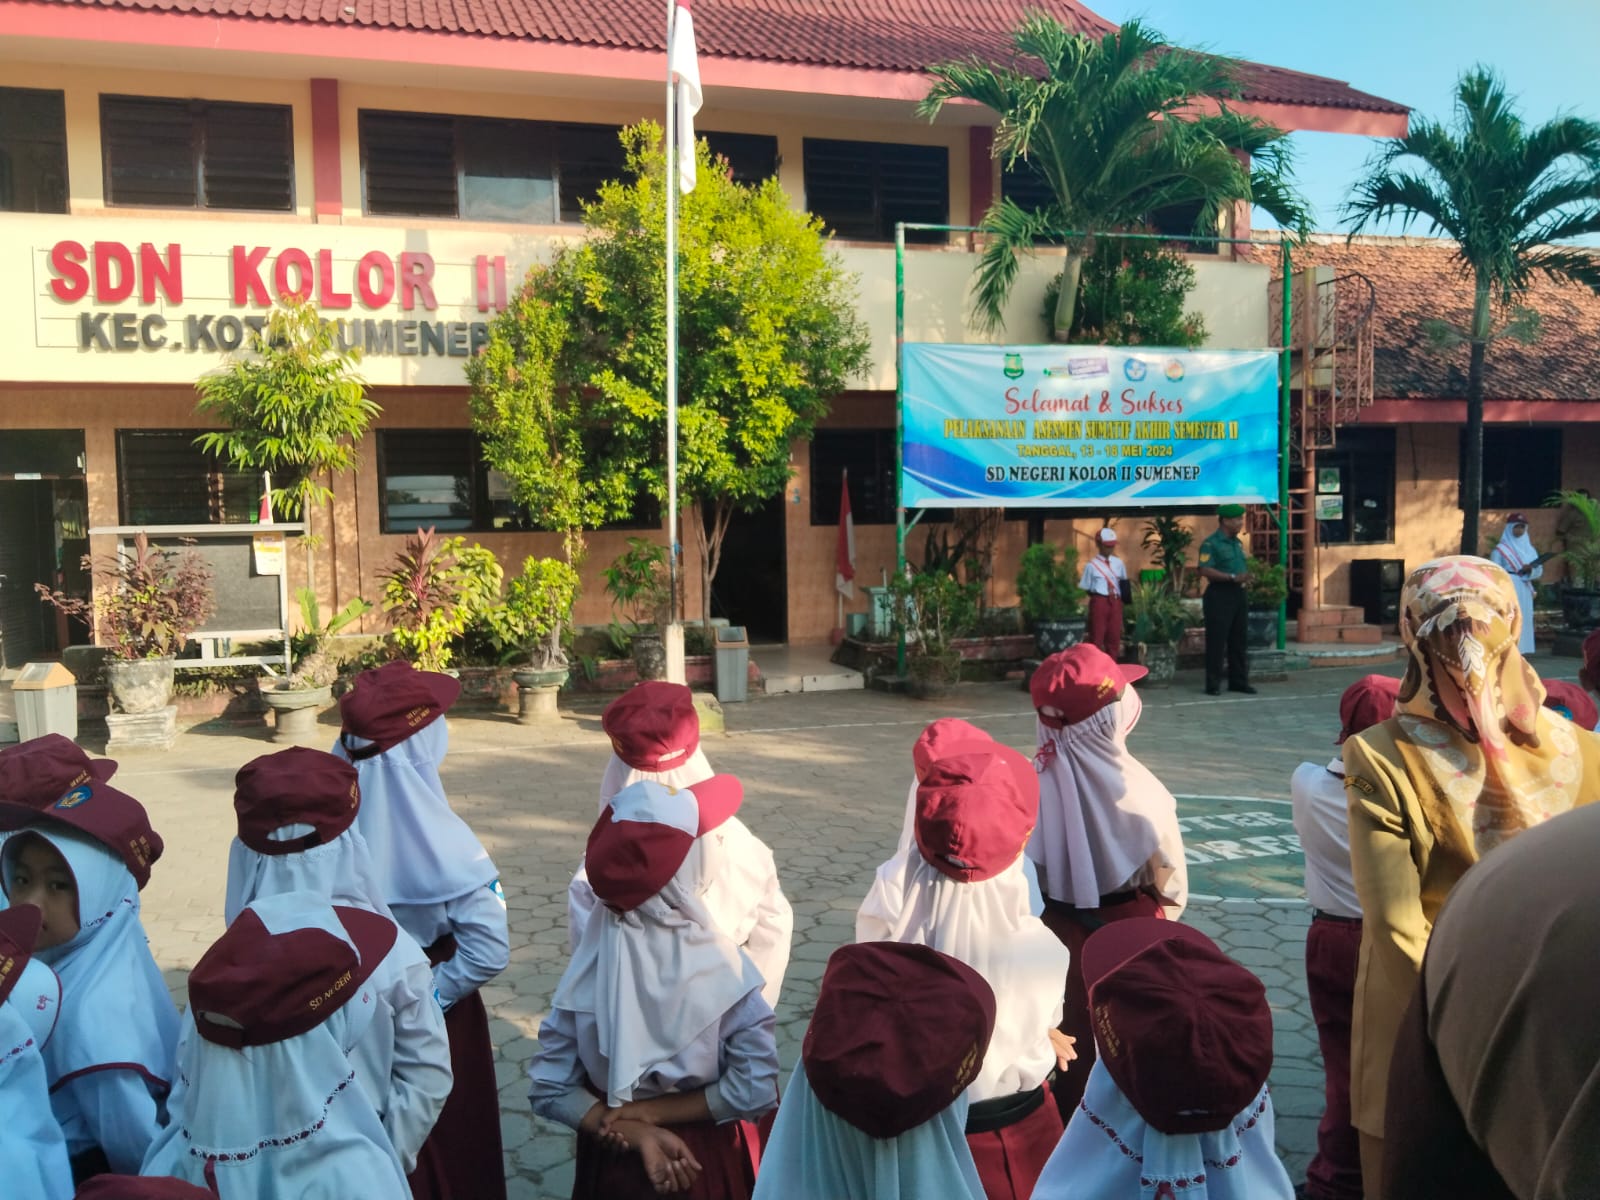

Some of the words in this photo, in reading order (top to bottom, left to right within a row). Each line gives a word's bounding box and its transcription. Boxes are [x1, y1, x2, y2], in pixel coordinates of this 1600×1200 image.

[51, 239, 184, 305] SDN
[233, 245, 438, 312] KOLOR
[476, 255, 507, 313] II
[1004, 387, 1090, 415] Selamat
[1098, 390, 1112, 413] &
[1121, 388, 1183, 415] Sukses
[944, 419, 1026, 439] PELAKSANAAN
[1033, 420, 1083, 440] ASESMEN
[1085, 420, 1131, 440] SUMATIF
[1134, 420, 1171, 440] AKHIR
[1174, 420, 1226, 440] SEMESTER
[1229, 421, 1239, 440] II
[1016, 444, 1077, 459] TANGGAL,
[1080, 445, 1095, 457] 13
[1104, 445, 1118, 457] 18
[1121, 445, 1143, 457] MEI
[1146, 444, 1173, 457] 2024
[986, 466, 1006, 481] SD
[1009, 466, 1066, 481] NEGERI
[1069, 466, 1118, 481] KOLOR
[1121, 466, 1132, 481] II
[1134, 465, 1200, 481] SUMENEP
[309, 996, 323, 1011] SD
